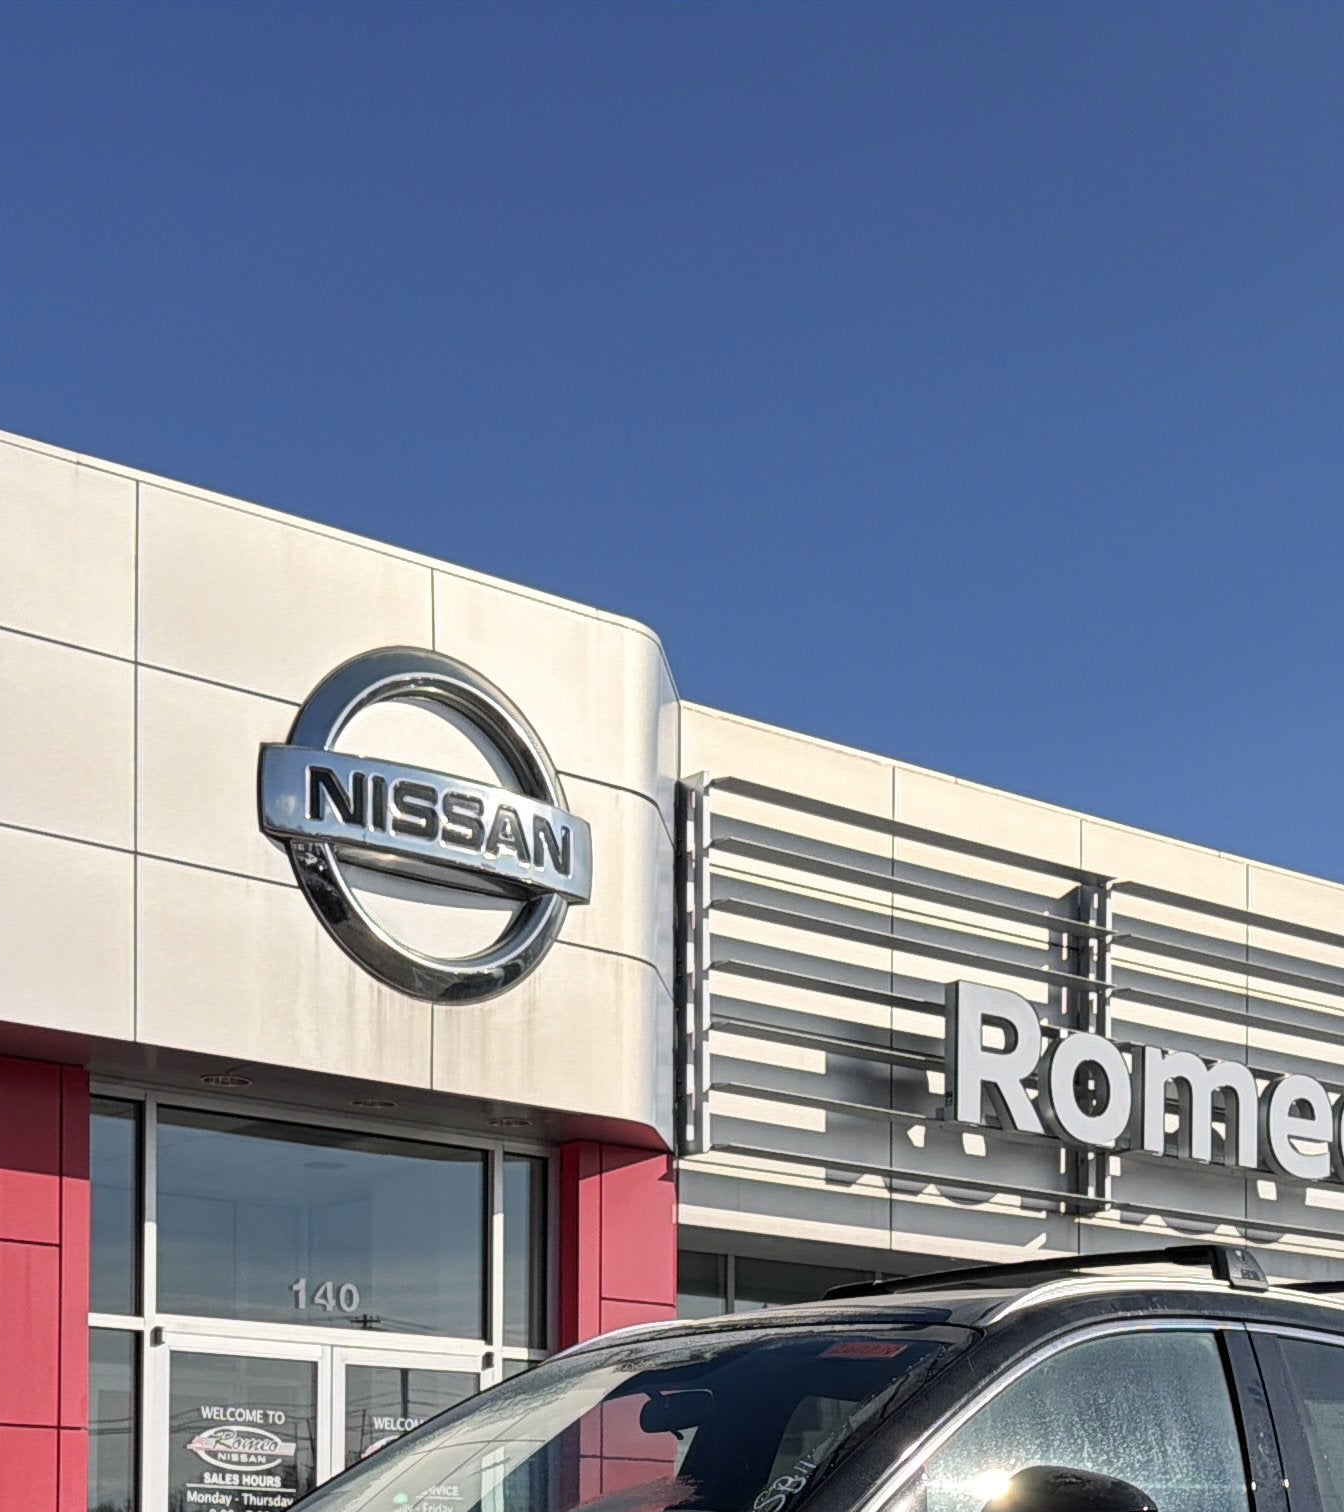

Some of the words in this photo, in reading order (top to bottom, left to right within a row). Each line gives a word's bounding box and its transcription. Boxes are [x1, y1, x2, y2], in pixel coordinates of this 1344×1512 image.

[305, 765, 574, 879] NISSAN
[290, 1278, 360, 1312] 140
[200, 1405, 264, 1424] WELCOME
[266, 1410, 285, 1425] TO
[208, 1428, 279, 1452] Romeo
[217, 1452, 266, 1464] NISSAN
[203, 1472, 239, 1486] SALES
[241, 1474, 282, 1488] HOURS
[186, 1490, 233, 1507] Monday
[241, 1493, 294, 1508] Thursday
